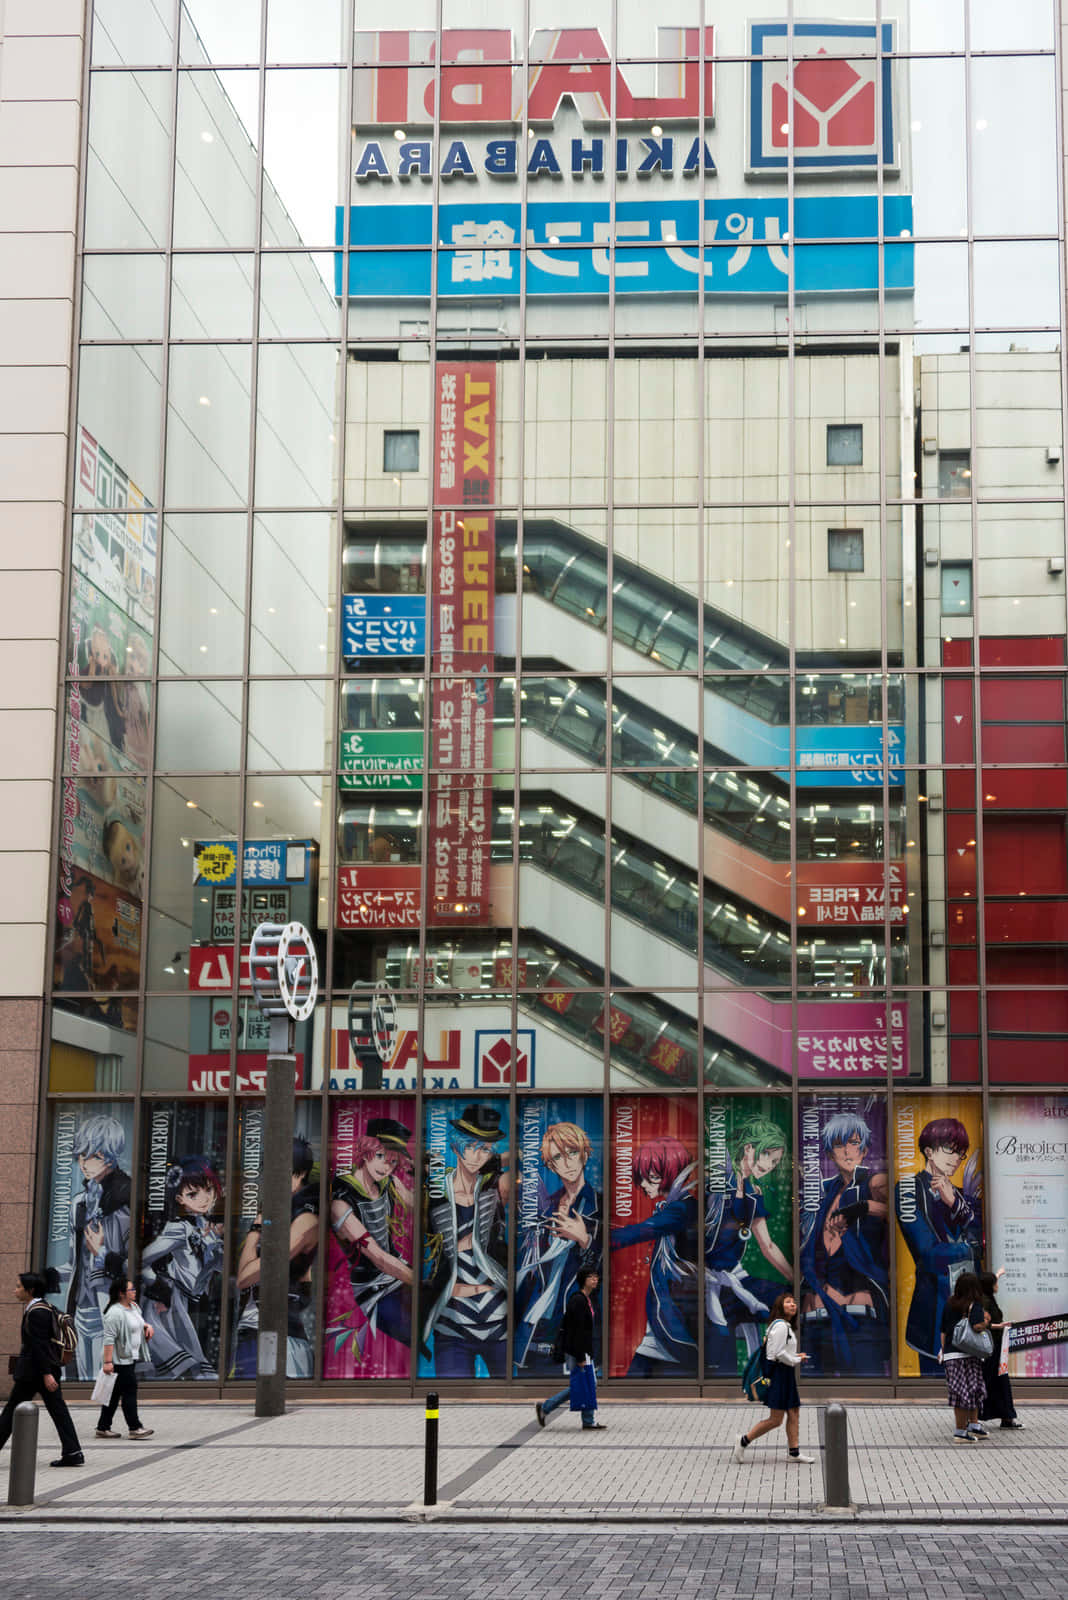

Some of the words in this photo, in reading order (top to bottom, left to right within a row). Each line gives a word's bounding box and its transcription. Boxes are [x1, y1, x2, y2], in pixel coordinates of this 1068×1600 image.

[56, 1112, 76, 1175] KITAKADO
[150, 1111, 169, 1173] KOREKUNI
[244, 1109, 263, 1178] KANESHIRO
[336, 1109, 354, 1141] ASHU
[430, 1107, 447, 1155] AIZOME
[522, 1107, 539, 1176] MASUNAGA
[616, 1106, 633, 1143] ONZAI
[709, 1106, 726, 1143] OSARI
[802, 1106, 819, 1141] NOME
[897, 1105, 916, 1168] SEKIMURA
[336, 1145, 353, 1177] YUTA
[429, 1158, 446, 1199] KENTO
[615, 1147, 633, 1217] MOMOTARO
[709, 1146, 727, 1193] HIKARU
[803, 1144, 821, 1212] TATSUHIRO
[51, 1179, 72, 1242] TOMOHISA
[148, 1177, 166, 1211] RYUJI
[242, 1183, 259, 1219] GOSHI
[521, 1177, 539, 1228] KAZUNA
[899, 1172, 918, 1223] MIKADO
